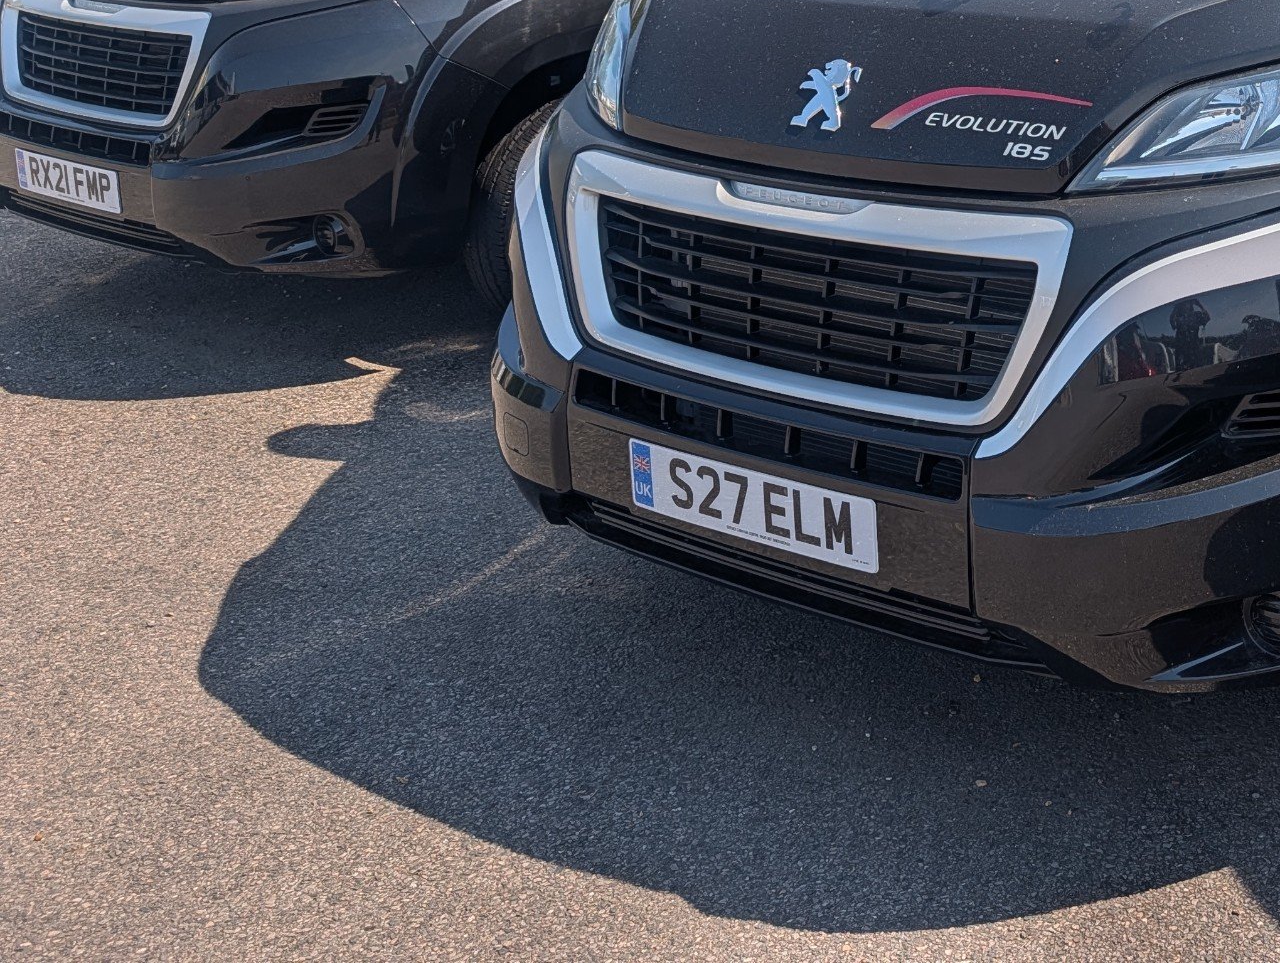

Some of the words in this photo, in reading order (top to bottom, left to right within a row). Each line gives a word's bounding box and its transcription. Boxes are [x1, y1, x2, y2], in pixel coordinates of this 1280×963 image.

[925, 112, 1067, 140] EVOLUTION
[1003, 142, 1052, 161] 185
[28, 156, 71, 195] RX21
[73, 166, 111, 203] FMP
[635, 480, 653, 498] UK
[669, 457, 749, 525] S27
[763, 481, 853, 555] ELM
